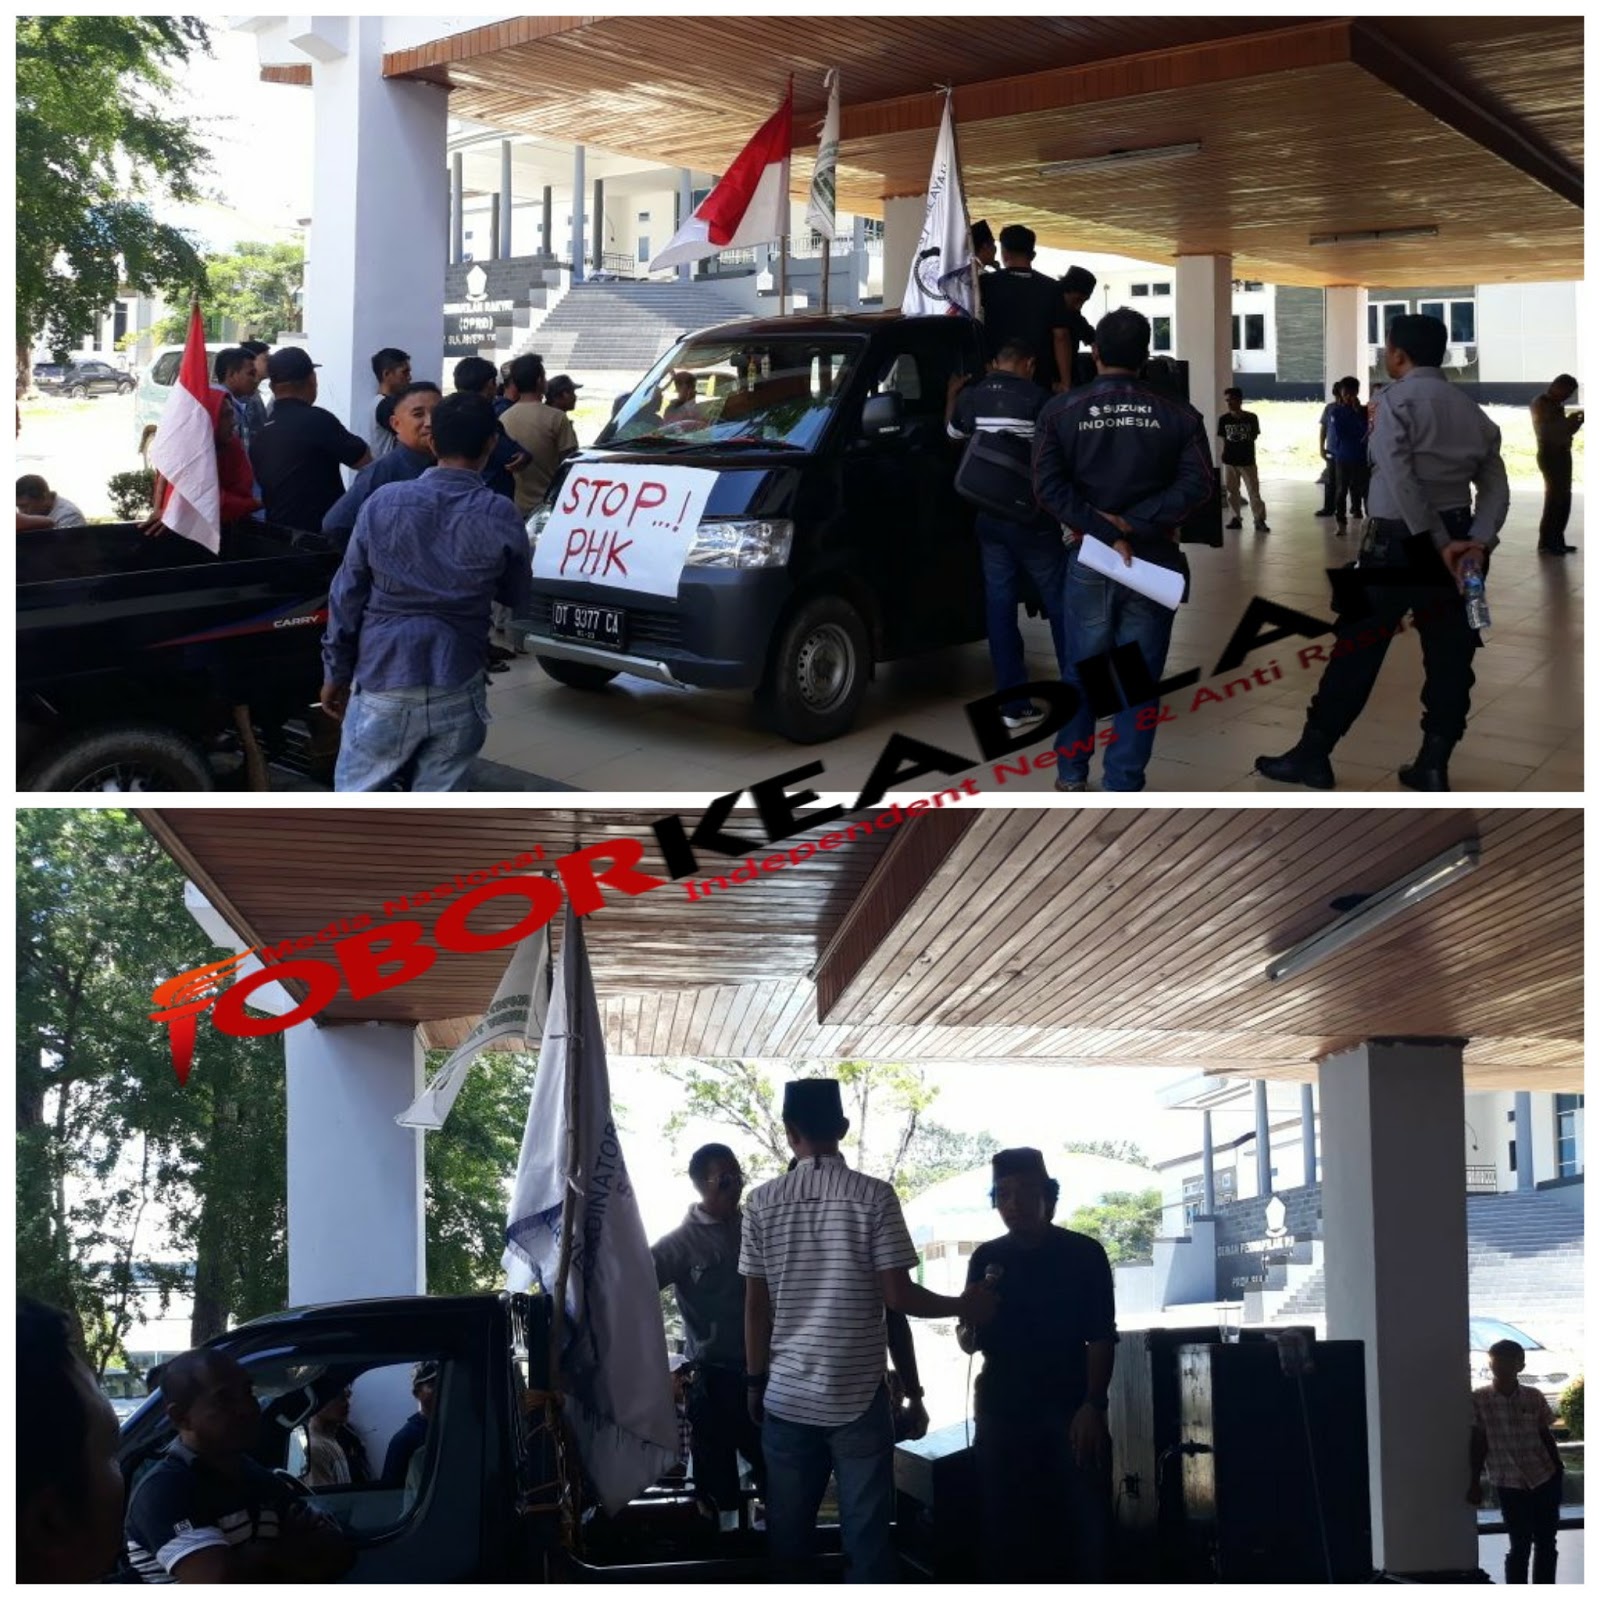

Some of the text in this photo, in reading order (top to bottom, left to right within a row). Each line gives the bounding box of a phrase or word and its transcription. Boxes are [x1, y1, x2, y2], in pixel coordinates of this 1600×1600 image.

[1103, 404, 1152, 414] SUZUKI
[1078, 416, 1161, 431] INDONESIA
[560, 528, 633, 577] PHK
[272, 615, 320, 629] CARRY
[574, 608, 600, 630] 9377
[605, 613, 619, 634] CA
